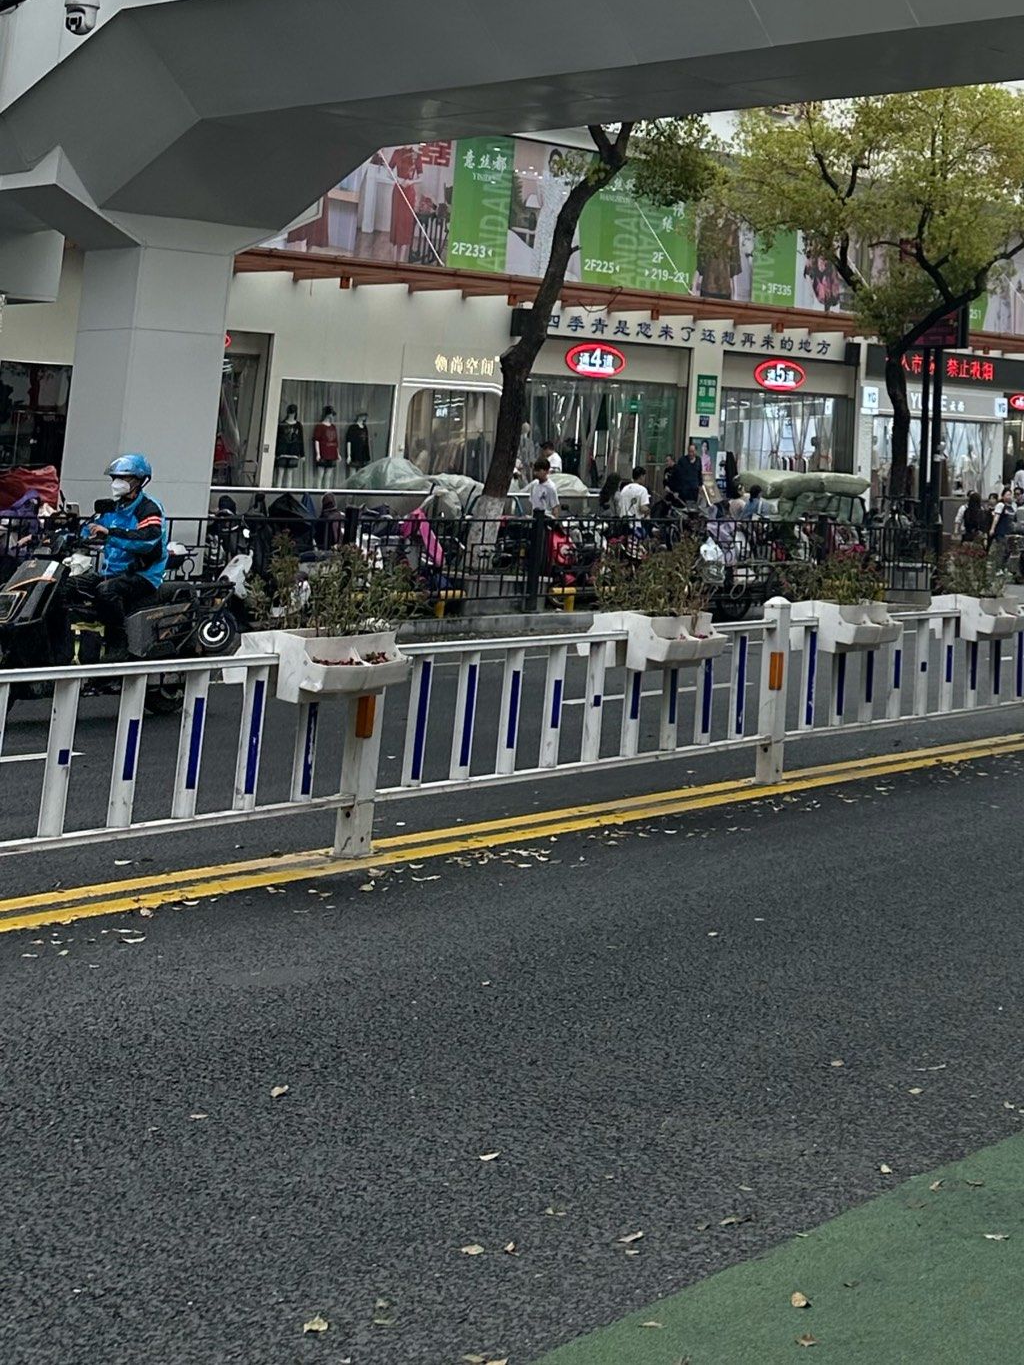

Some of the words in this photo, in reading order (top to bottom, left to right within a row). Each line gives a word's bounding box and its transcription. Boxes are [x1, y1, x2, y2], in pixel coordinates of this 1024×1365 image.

[452, 242, 486, 258] 2F233
[652, 252, 665, 264] 2F
[584, 259, 615, 274] 2F225
[547, 315, 832, 356] 四季青是您来了还想再来的地方
